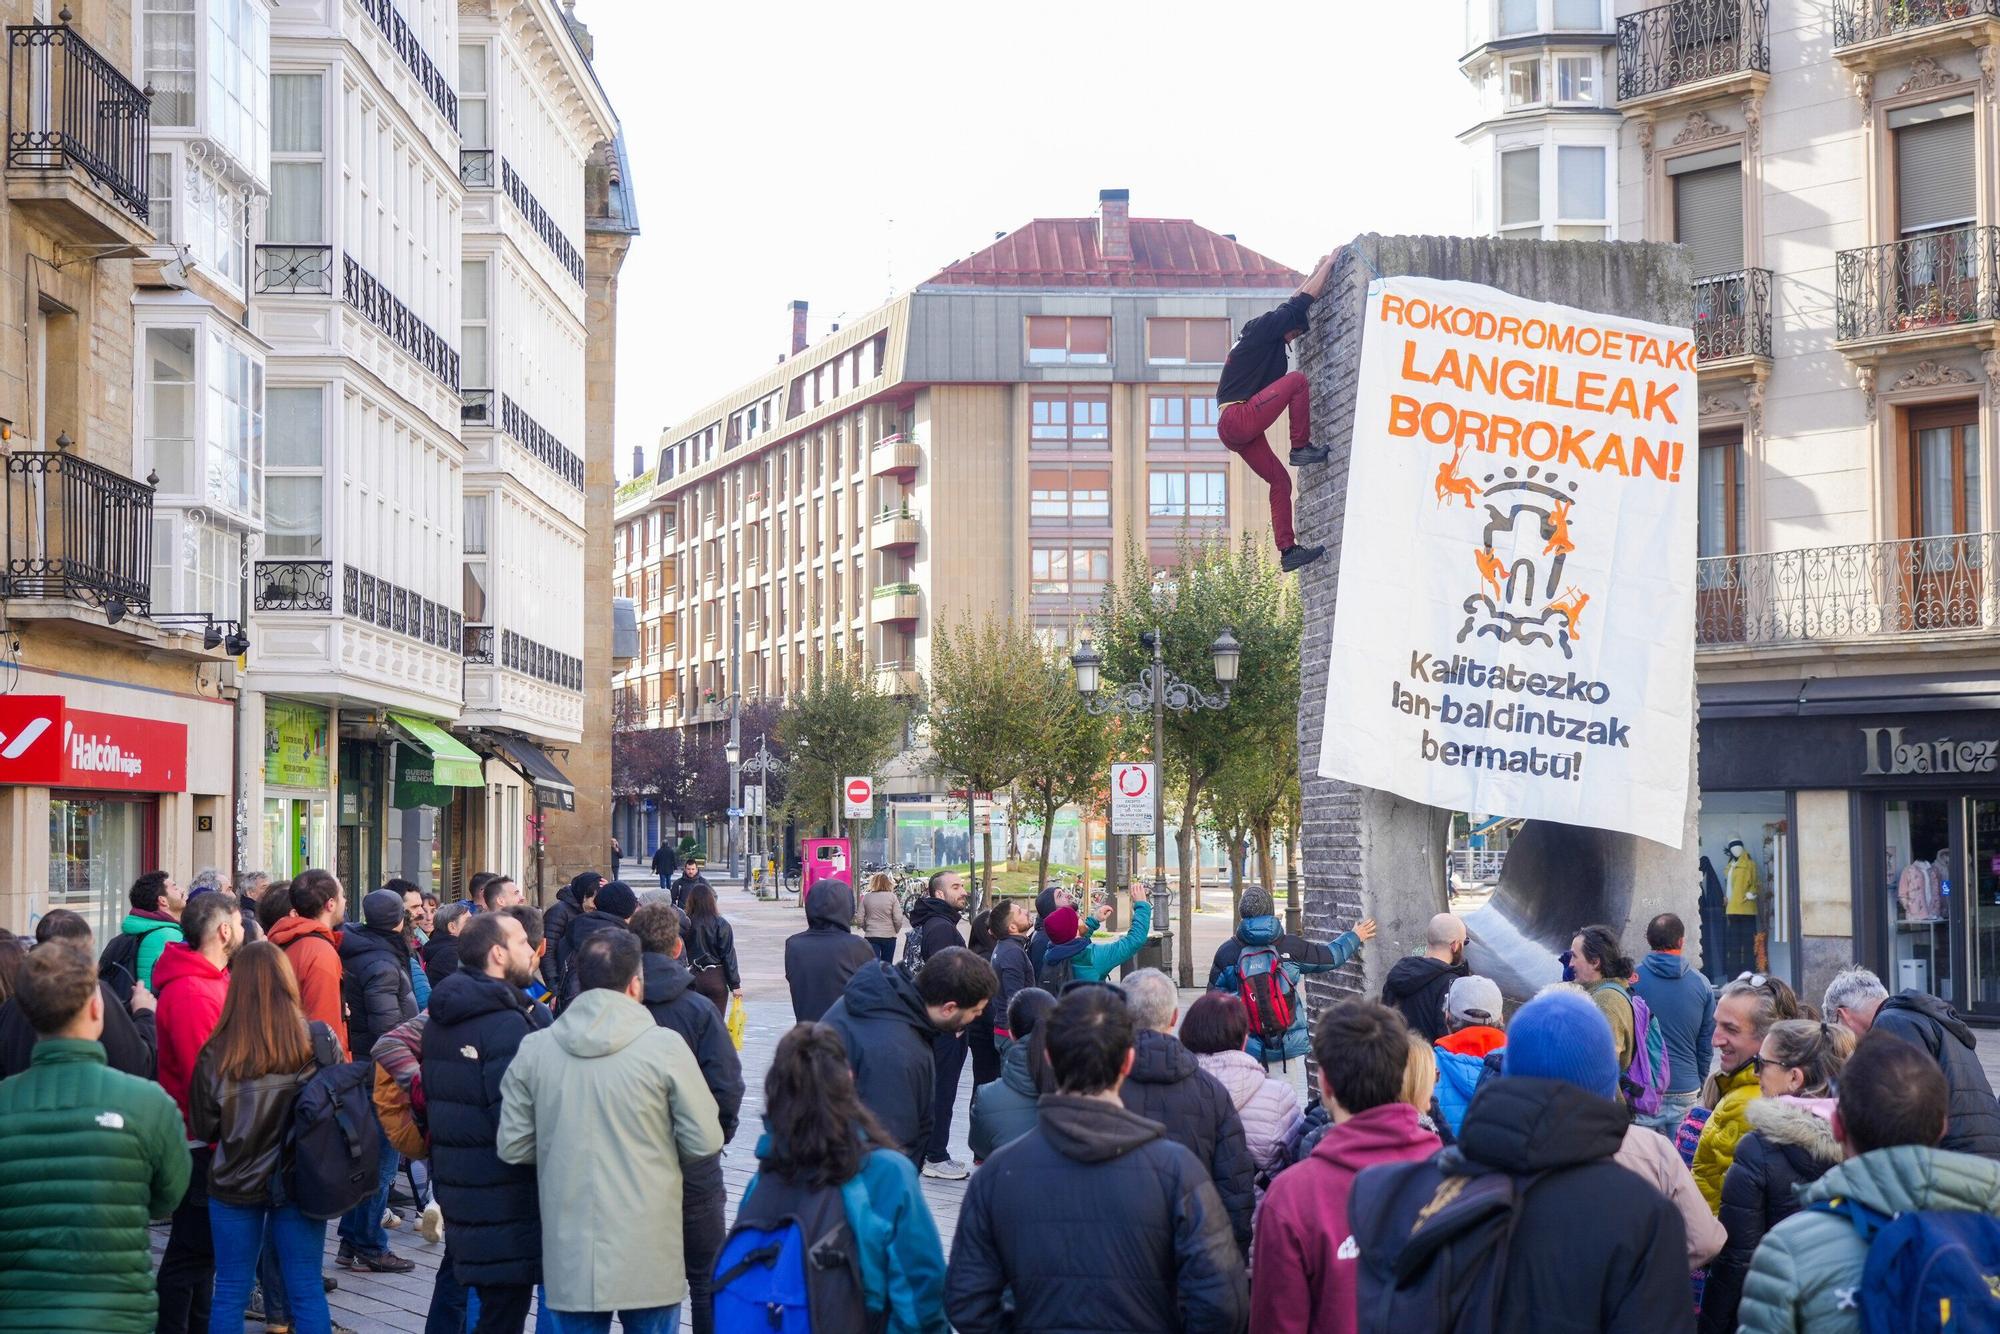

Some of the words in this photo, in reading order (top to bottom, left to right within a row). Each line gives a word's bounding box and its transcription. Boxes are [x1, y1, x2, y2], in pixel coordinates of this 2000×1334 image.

[1401, 341, 1679, 424] LANGILEAK
[1388, 394, 1684, 483] BORROKAN!
[1410, 650, 1610, 705] Kalitatezko
[1392, 681, 1630, 748] lan-baldintzak
[71, 733, 120, 772] Halcón
[120, 752, 142, 778] viajes
[200, 818, 210, 830] 3
